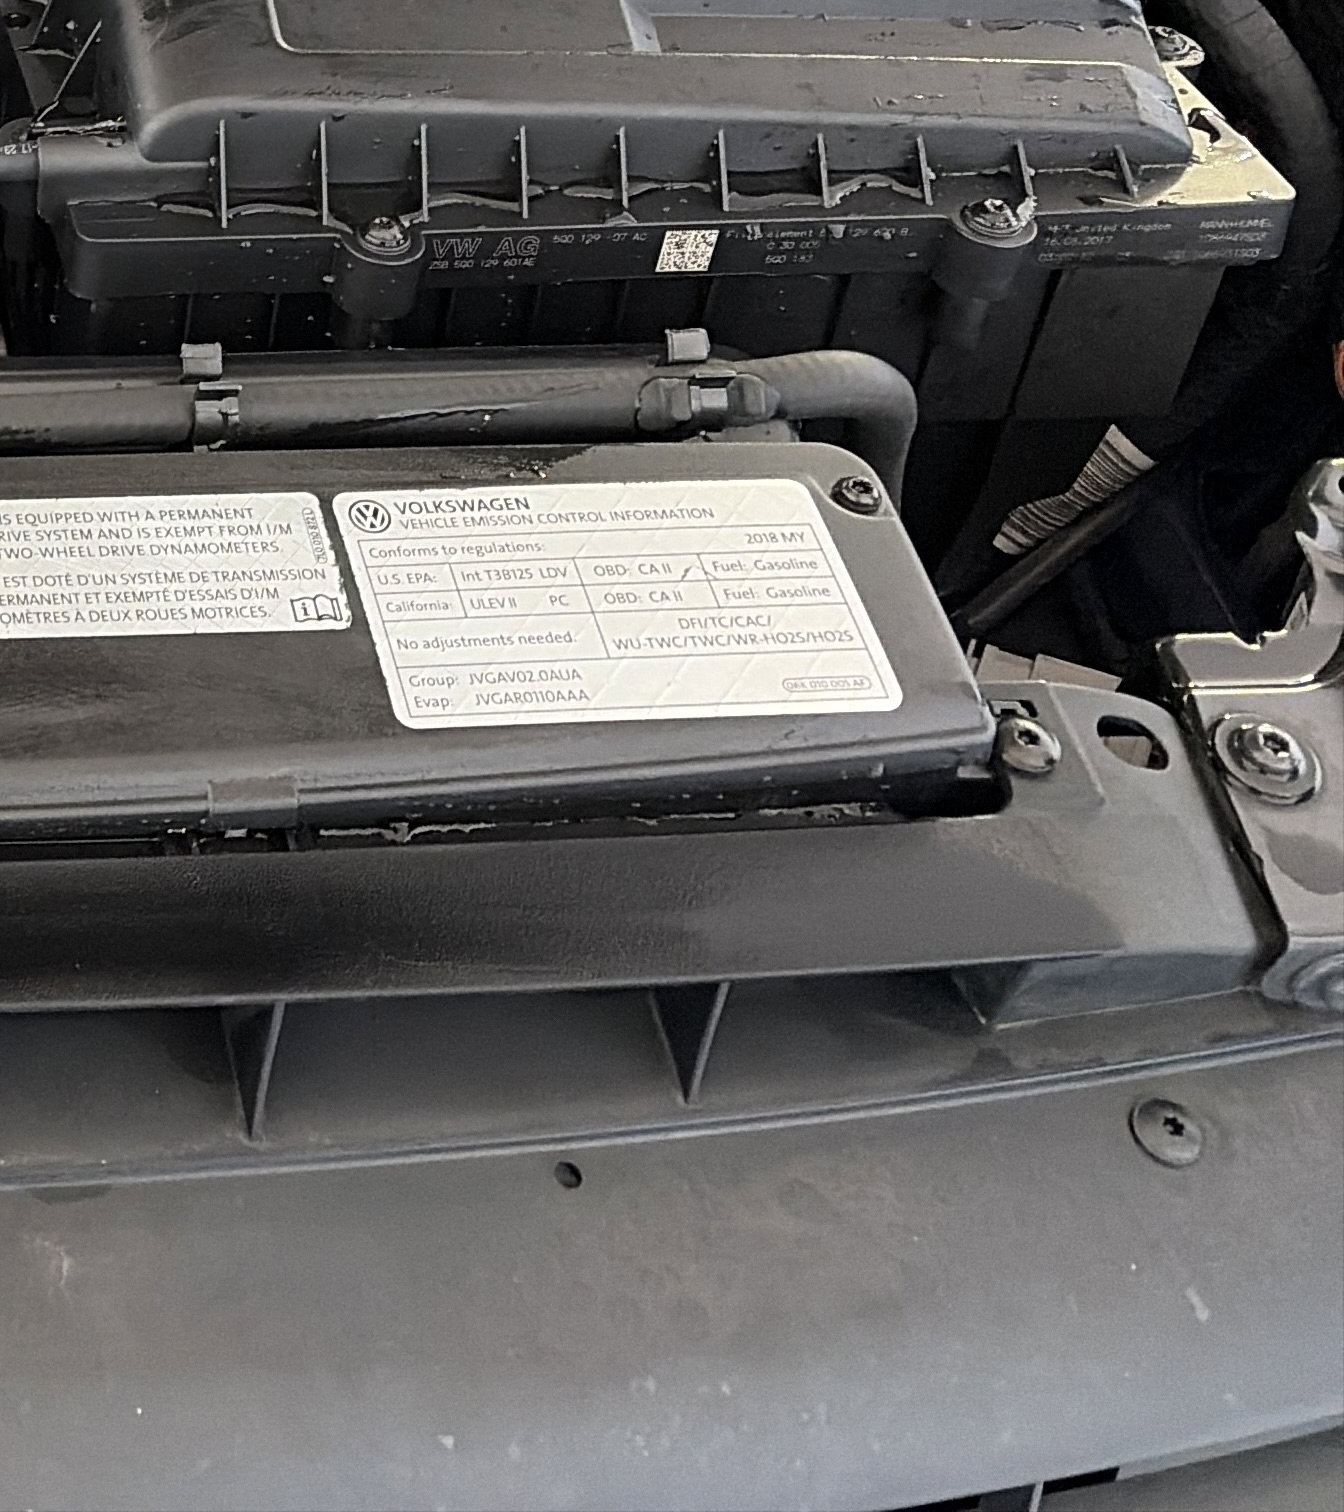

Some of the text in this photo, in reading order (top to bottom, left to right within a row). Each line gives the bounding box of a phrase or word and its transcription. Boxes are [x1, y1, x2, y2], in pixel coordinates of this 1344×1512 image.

[433, 237, 482, 258] VW
[494, 236, 540, 257] AG
[394, 497, 531, 515] VOLKSWAGEN
[16, 512, 93, 527] EQUIPPED
[97, 511, 139, 522] WITH
[159, 507, 253, 521] PERMANENT
[399, 508, 715, 530] VEHICLE EMISSION CONTROL INFORMATION
[36, 529, 93, 542] SYSTEM
[98, 528, 132, 538] AND
[155, 526, 214, 537] EXEMPT
[219, 525, 263, 536] FROM
[267, 524, 292, 535] I/M
[745, 532, 806, 544] 2018 MY
[99, 545, 144, 556] DRIVE
[369, 542, 545, 559] Conforms regulations:
[754, 558, 818, 571] Gasoline
[3, 576, 27, 588] EST
[33, 574, 73, 587] DOTÉ
[121, 570, 185, 585] SYSTÈME
[212, 568, 326, 582] TRANSMISSION
[485, 567, 567, 580] T3B125 LDV
[106, 588, 169, 603] EXEMPTÉ
[174, 589, 237, 602] D'ESSAIS
[604, 592, 641, 604] OBD:
[766, 586, 832, 598] Gasoline
[470, 597, 506, 609] ULEV
[90, 610, 132, 622] DEUX
[137, 608, 188, 621] ROUES
[192, 606, 271, 620] MOTRICES.
[678, 615, 771, 629] DFI/TC/CAC/
[397, 632, 577, 652] No adjustments needed.
[409, 669, 583, 689] Group: JVGAV02.0AUA
